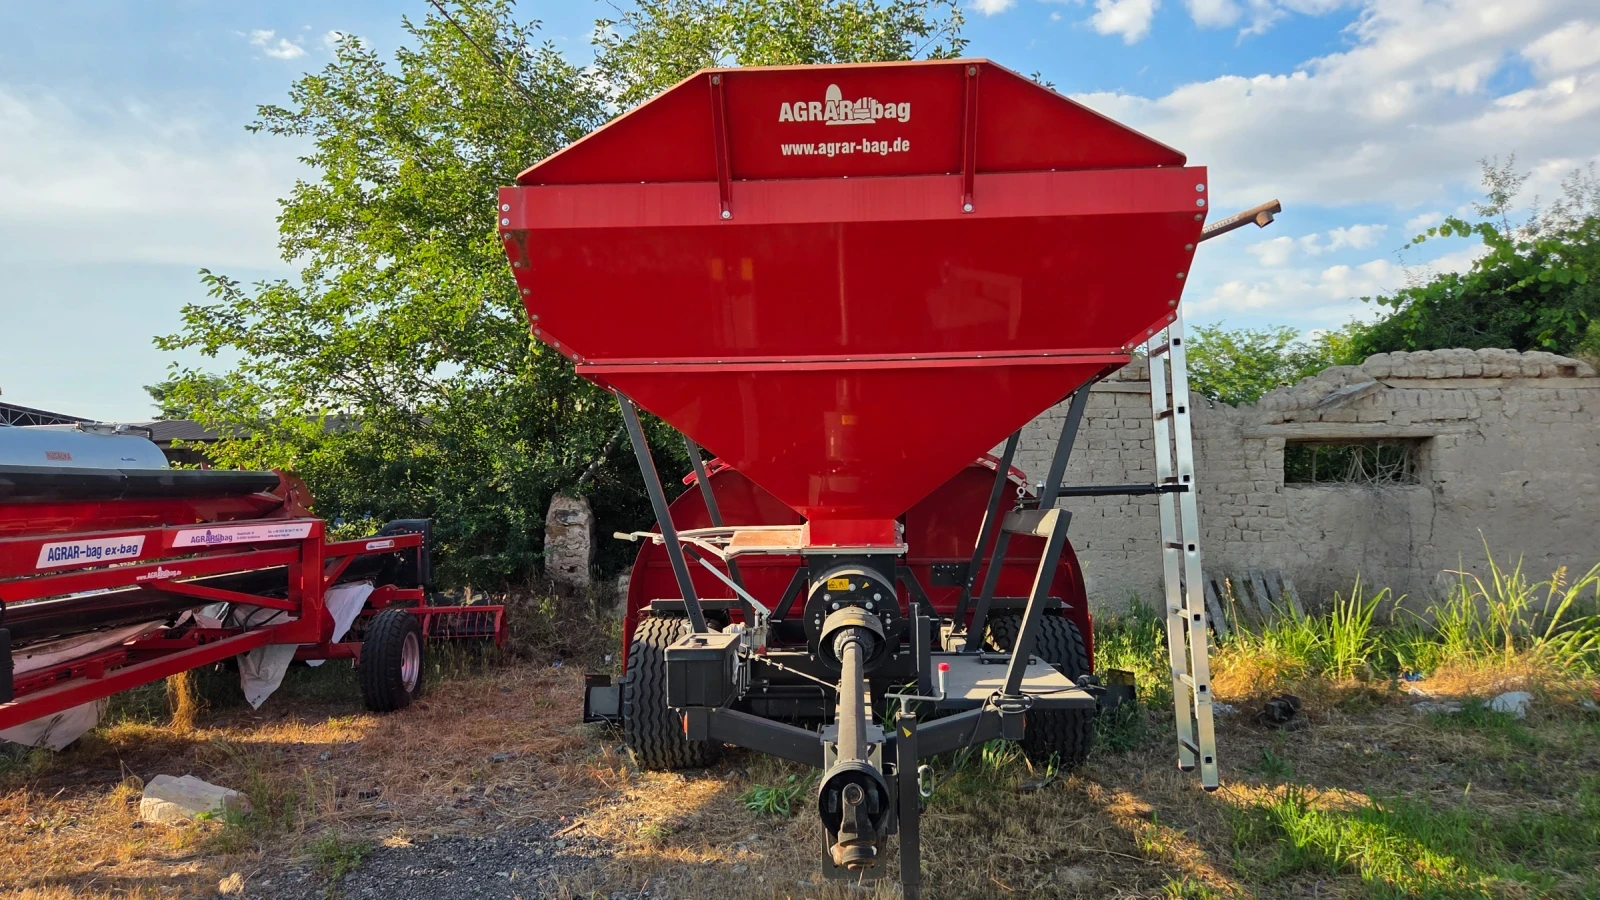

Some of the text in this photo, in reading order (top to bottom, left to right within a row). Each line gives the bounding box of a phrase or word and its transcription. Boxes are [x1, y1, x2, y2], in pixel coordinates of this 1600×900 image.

[779, 99, 911, 122] AGRAR bag
[781, 137, 910, 157] www.agrar-bag.de
[47, 545, 102, 561] AGRAR-bag
